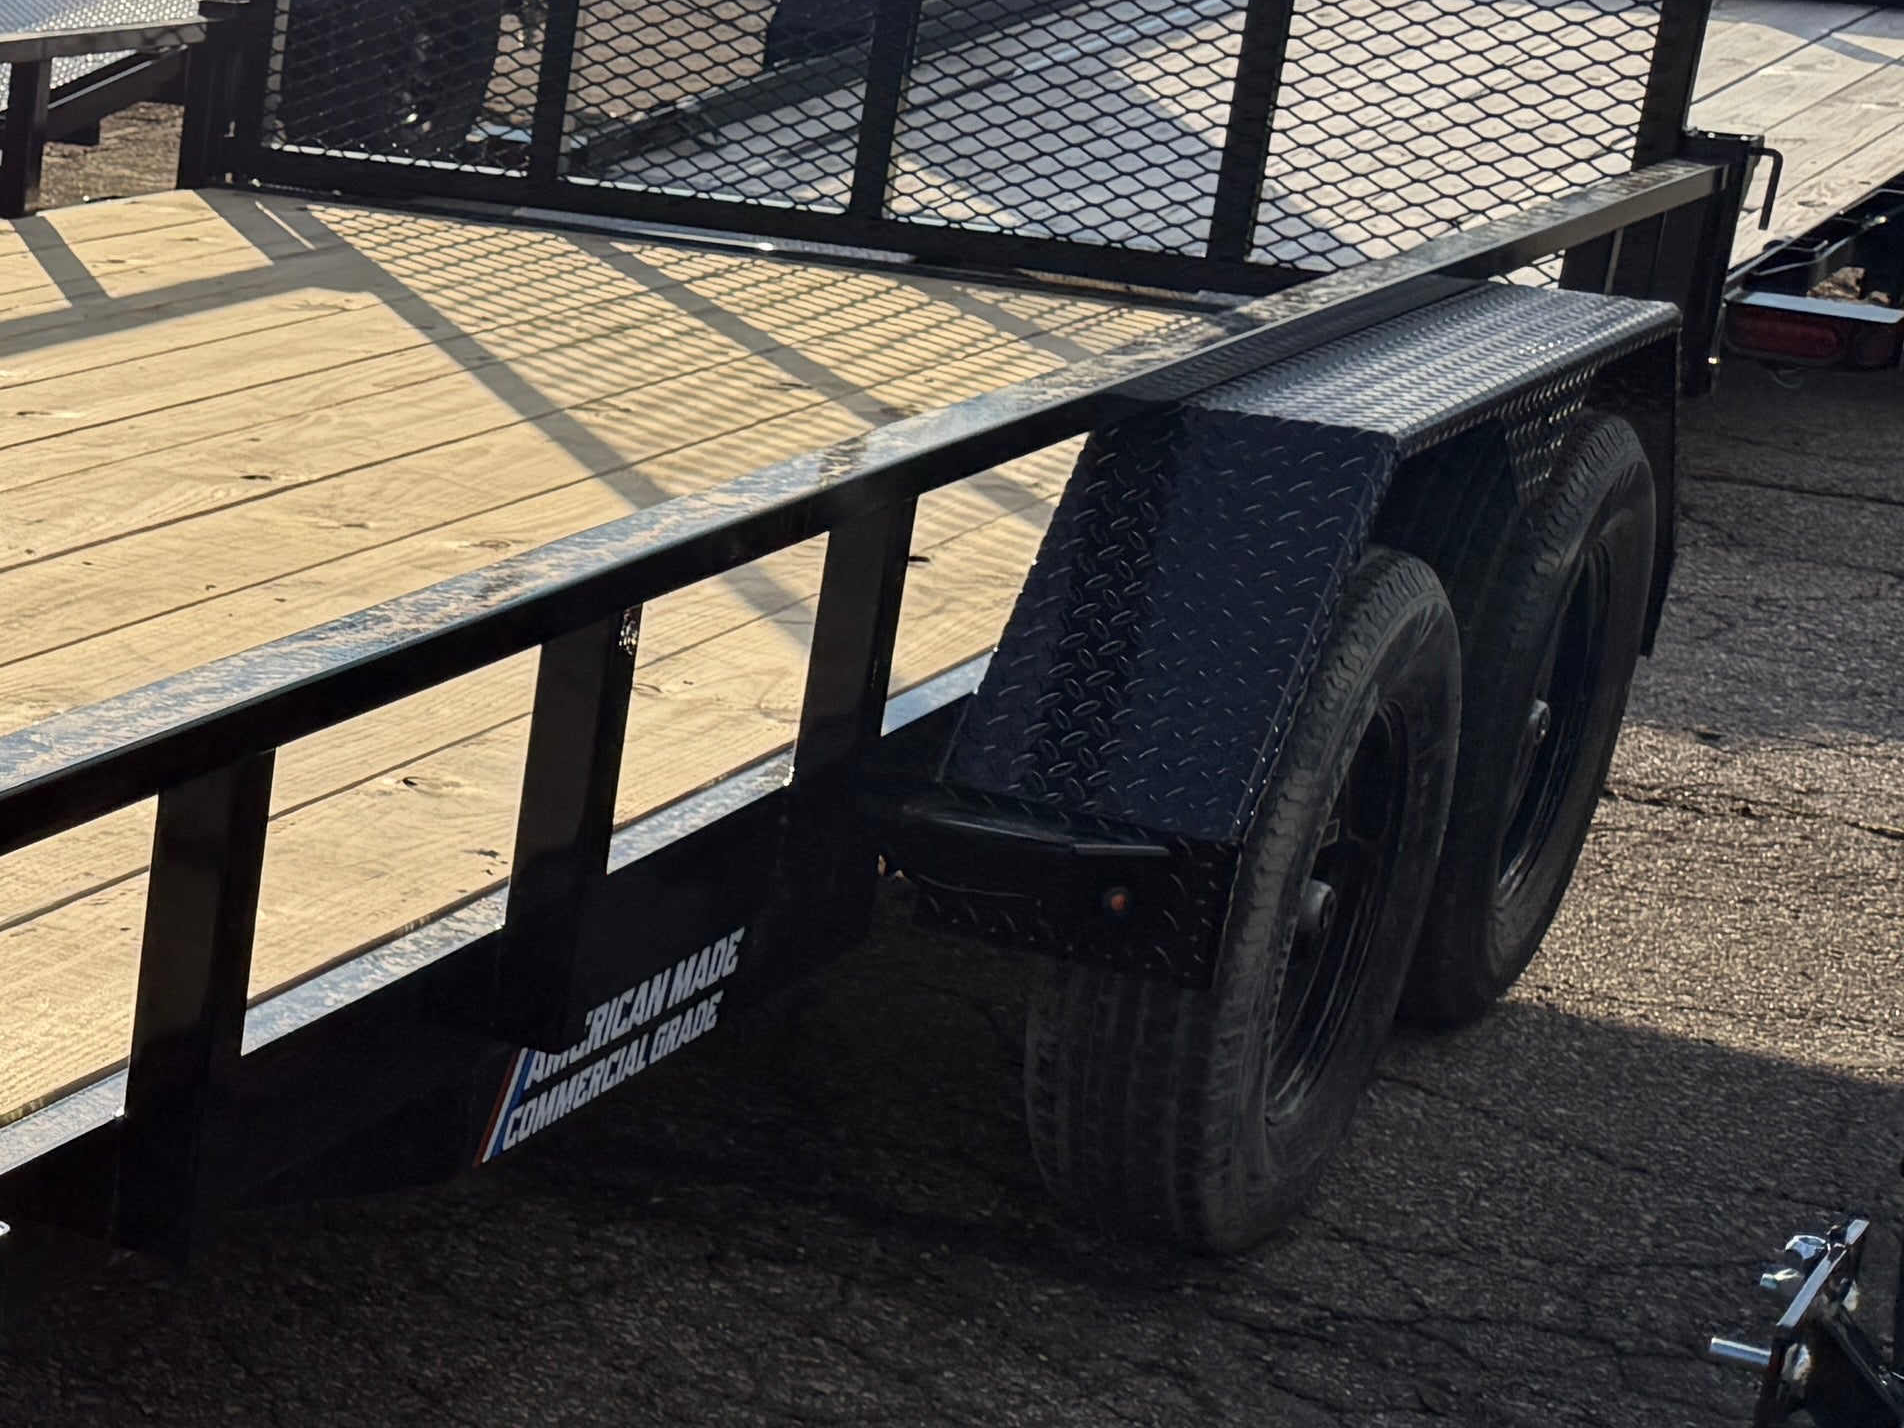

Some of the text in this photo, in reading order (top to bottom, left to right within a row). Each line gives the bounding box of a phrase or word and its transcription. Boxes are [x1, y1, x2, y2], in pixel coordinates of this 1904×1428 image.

[666, 926, 745, 1009] MADE
[502, 990, 724, 1151] COMMERCIAL GRADE
